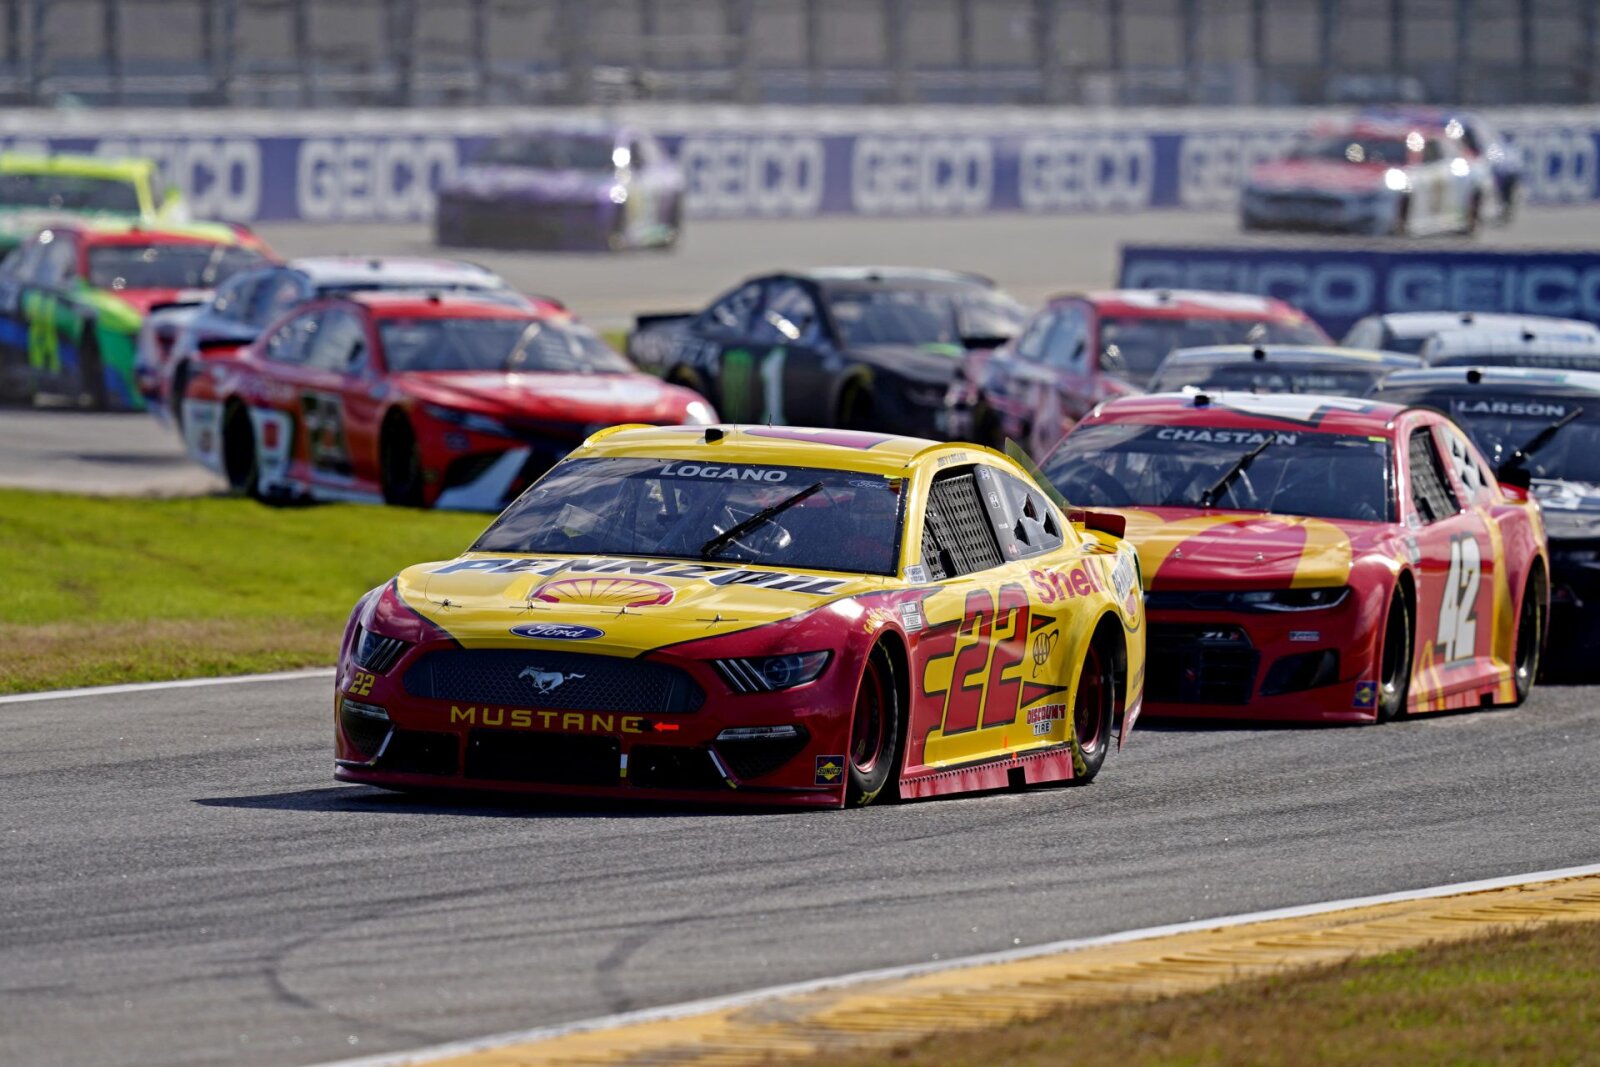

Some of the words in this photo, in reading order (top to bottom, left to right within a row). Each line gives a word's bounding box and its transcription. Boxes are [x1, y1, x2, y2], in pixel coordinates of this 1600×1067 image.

[852, 137, 993, 214] GEICO
[1020, 136, 1153, 210] GEICO
[1457, 401, 1565, 417] LARSON
[1156, 428, 1297, 446] CHASTAN
[659, 463, 788, 482] LOGANO
[430, 558, 846, 595] PENNZOIL
[1028, 558, 1104, 604] Shell
[1435, 531, 1480, 669] 42
[528, 624, 584, 639] Ford
[942, 582, 1029, 736] 22
[348, 671, 376, 696] 22
[1027, 704, 1066, 724] DISCOUNT
[1034, 722, 1050, 733] TIRE
[818, 766, 841, 775] SUNOCO
